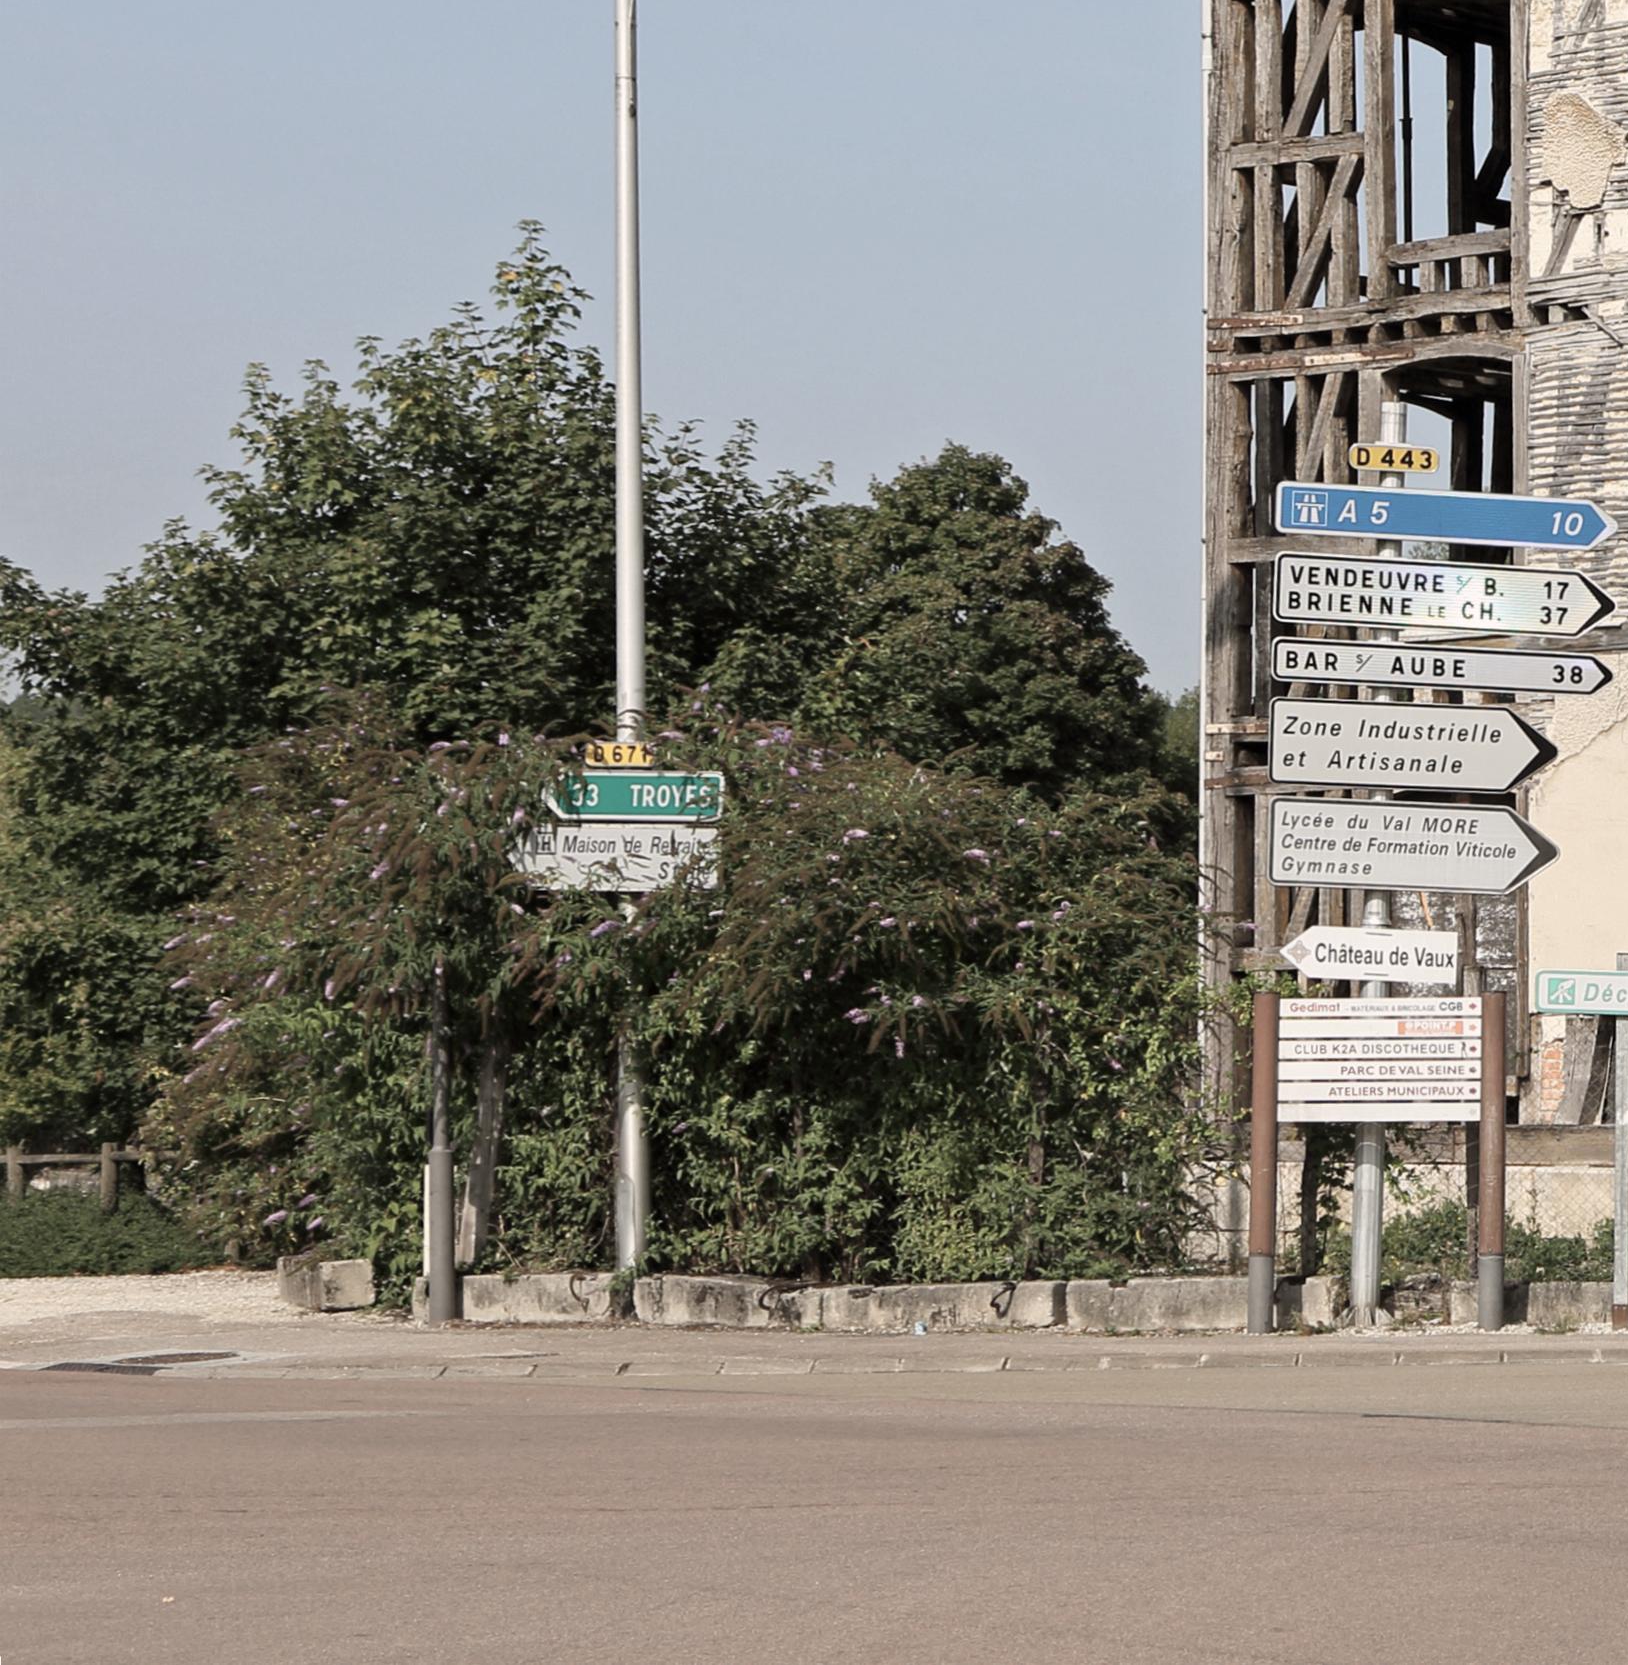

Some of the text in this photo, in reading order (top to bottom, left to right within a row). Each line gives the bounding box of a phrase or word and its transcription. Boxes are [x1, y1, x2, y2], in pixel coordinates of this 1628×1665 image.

[1357, 447, 1432, 469] D 443
[1337, 499, 1584, 537] A 5 10
[1290, 565, 1445, 593] VENDEUVRE
[1484, 577, 1504, 597] B.
[1543, 580, 1569, 600] 17
[1288, 591, 1568, 625] BRIENNE LE CH. 37
[1286, 651, 1338, 671] BAR
[1391, 656, 1466, 678] AUBE
[1552, 664, 1584, 684] 38
[1283, 715, 1502, 744] Zone Industrielle
[593, 745, 648, 763] D 671
[1283, 750, 1464, 774] et Artisanale
[630, 784, 711, 808] TROYES
[1281, 811, 1479, 835] Lycée du Val MORE
[562, 836, 616, 854] Maison
[624, 836, 642, 853] de
[1281, 833, 1517, 859] Centre de Formation Viticole
[1281, 856, 1373, 876] Gymnase
[1315, 942, 1455, 970] Château de Vaux
[1290, 1002, 1340, 1013] Gedimat
[1439, 1001, 1463, 1012] CGB
[1294, 1043, 1455, 1055] CLUB K2A DISCOTHEQUE
[1340, 1065, 1465, 1076] PARC DE VAL SEINE
[1328, 1085, 1465, 1097] ATELIERS MUNICIPAUX
